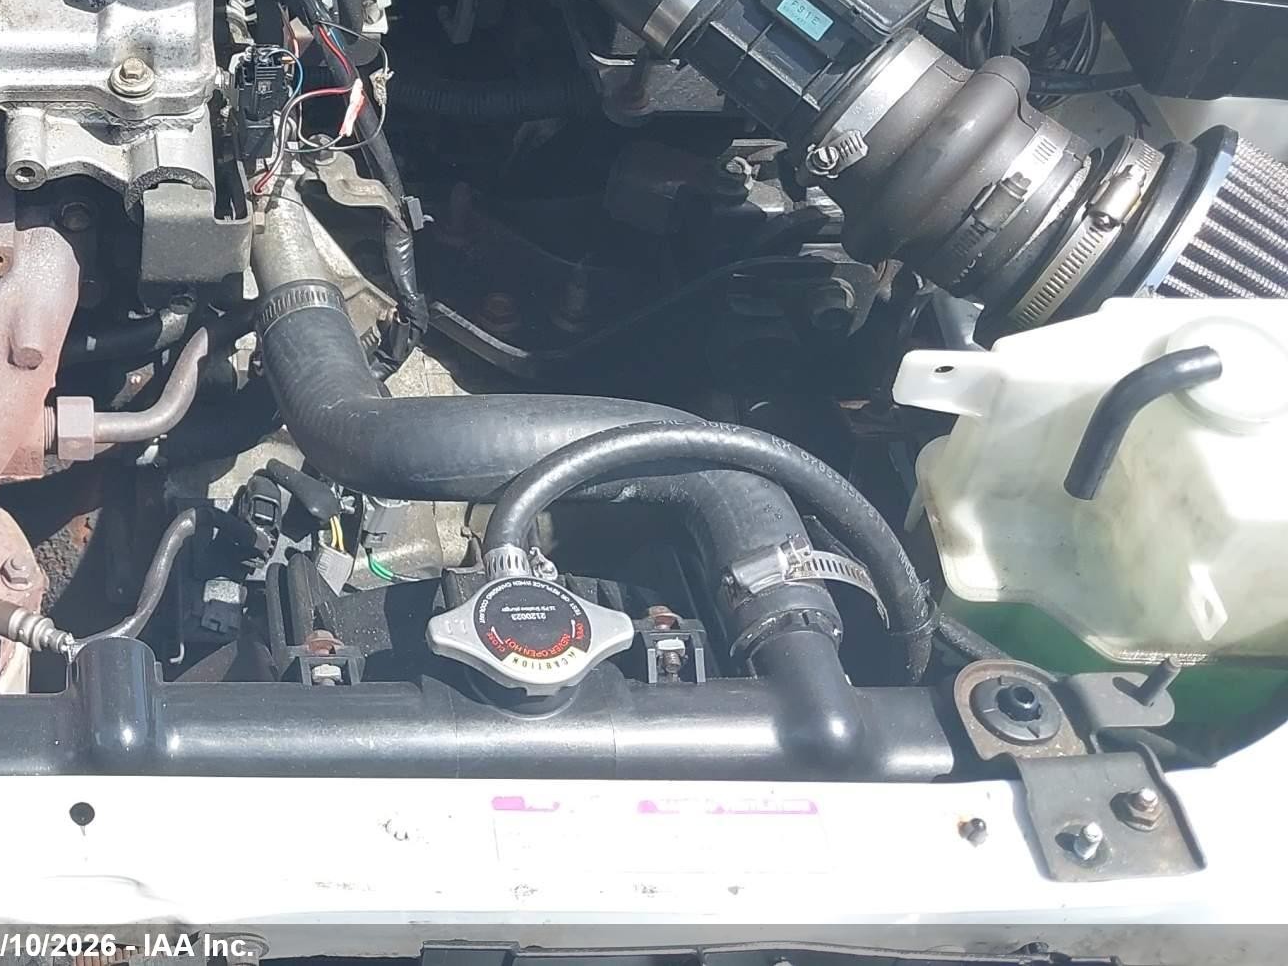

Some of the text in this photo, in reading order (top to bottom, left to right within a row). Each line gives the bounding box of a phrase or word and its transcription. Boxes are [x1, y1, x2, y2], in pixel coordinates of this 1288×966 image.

[504, 637, 523, 653] HOT
[523, 647, 549, 658] OPEN
[512, 656, 569, 671] CAUTION
